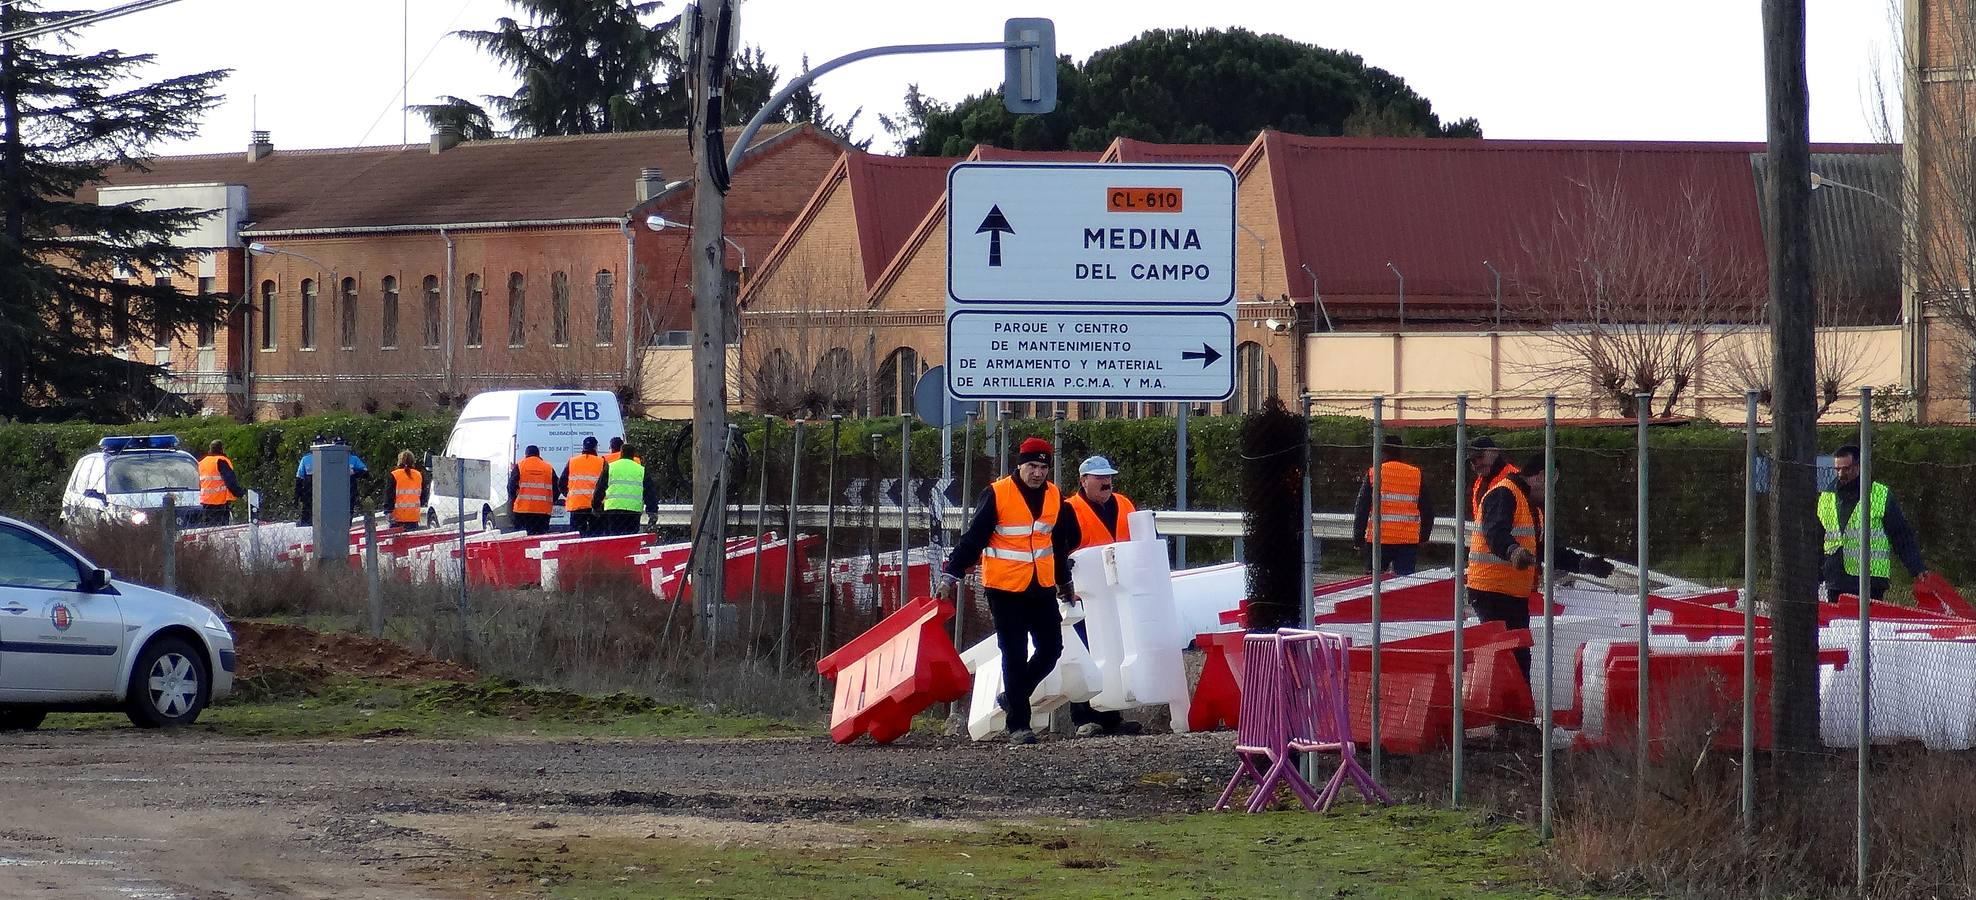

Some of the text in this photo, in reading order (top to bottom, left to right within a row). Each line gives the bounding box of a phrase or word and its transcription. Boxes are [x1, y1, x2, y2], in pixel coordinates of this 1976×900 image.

[1112, 192, 1178, 208] CL-610
[1083, 228, 1202, 250] MEDINA
[1075, 263, 1210, 281] DEL CAMPO
[994, 322, 1129, 334] PARQUE Y CENTRO
[991, 340, 1131, 352] DE MANTENIMIENTO
[959, 358, 1163, 370] DE ARMAMENTO Y MATERIAL
[957, 376, 1167, 389] DE ARTILLERIA P.C.M.A. Y M.A.
[551, 401, 600, 421] AEB
